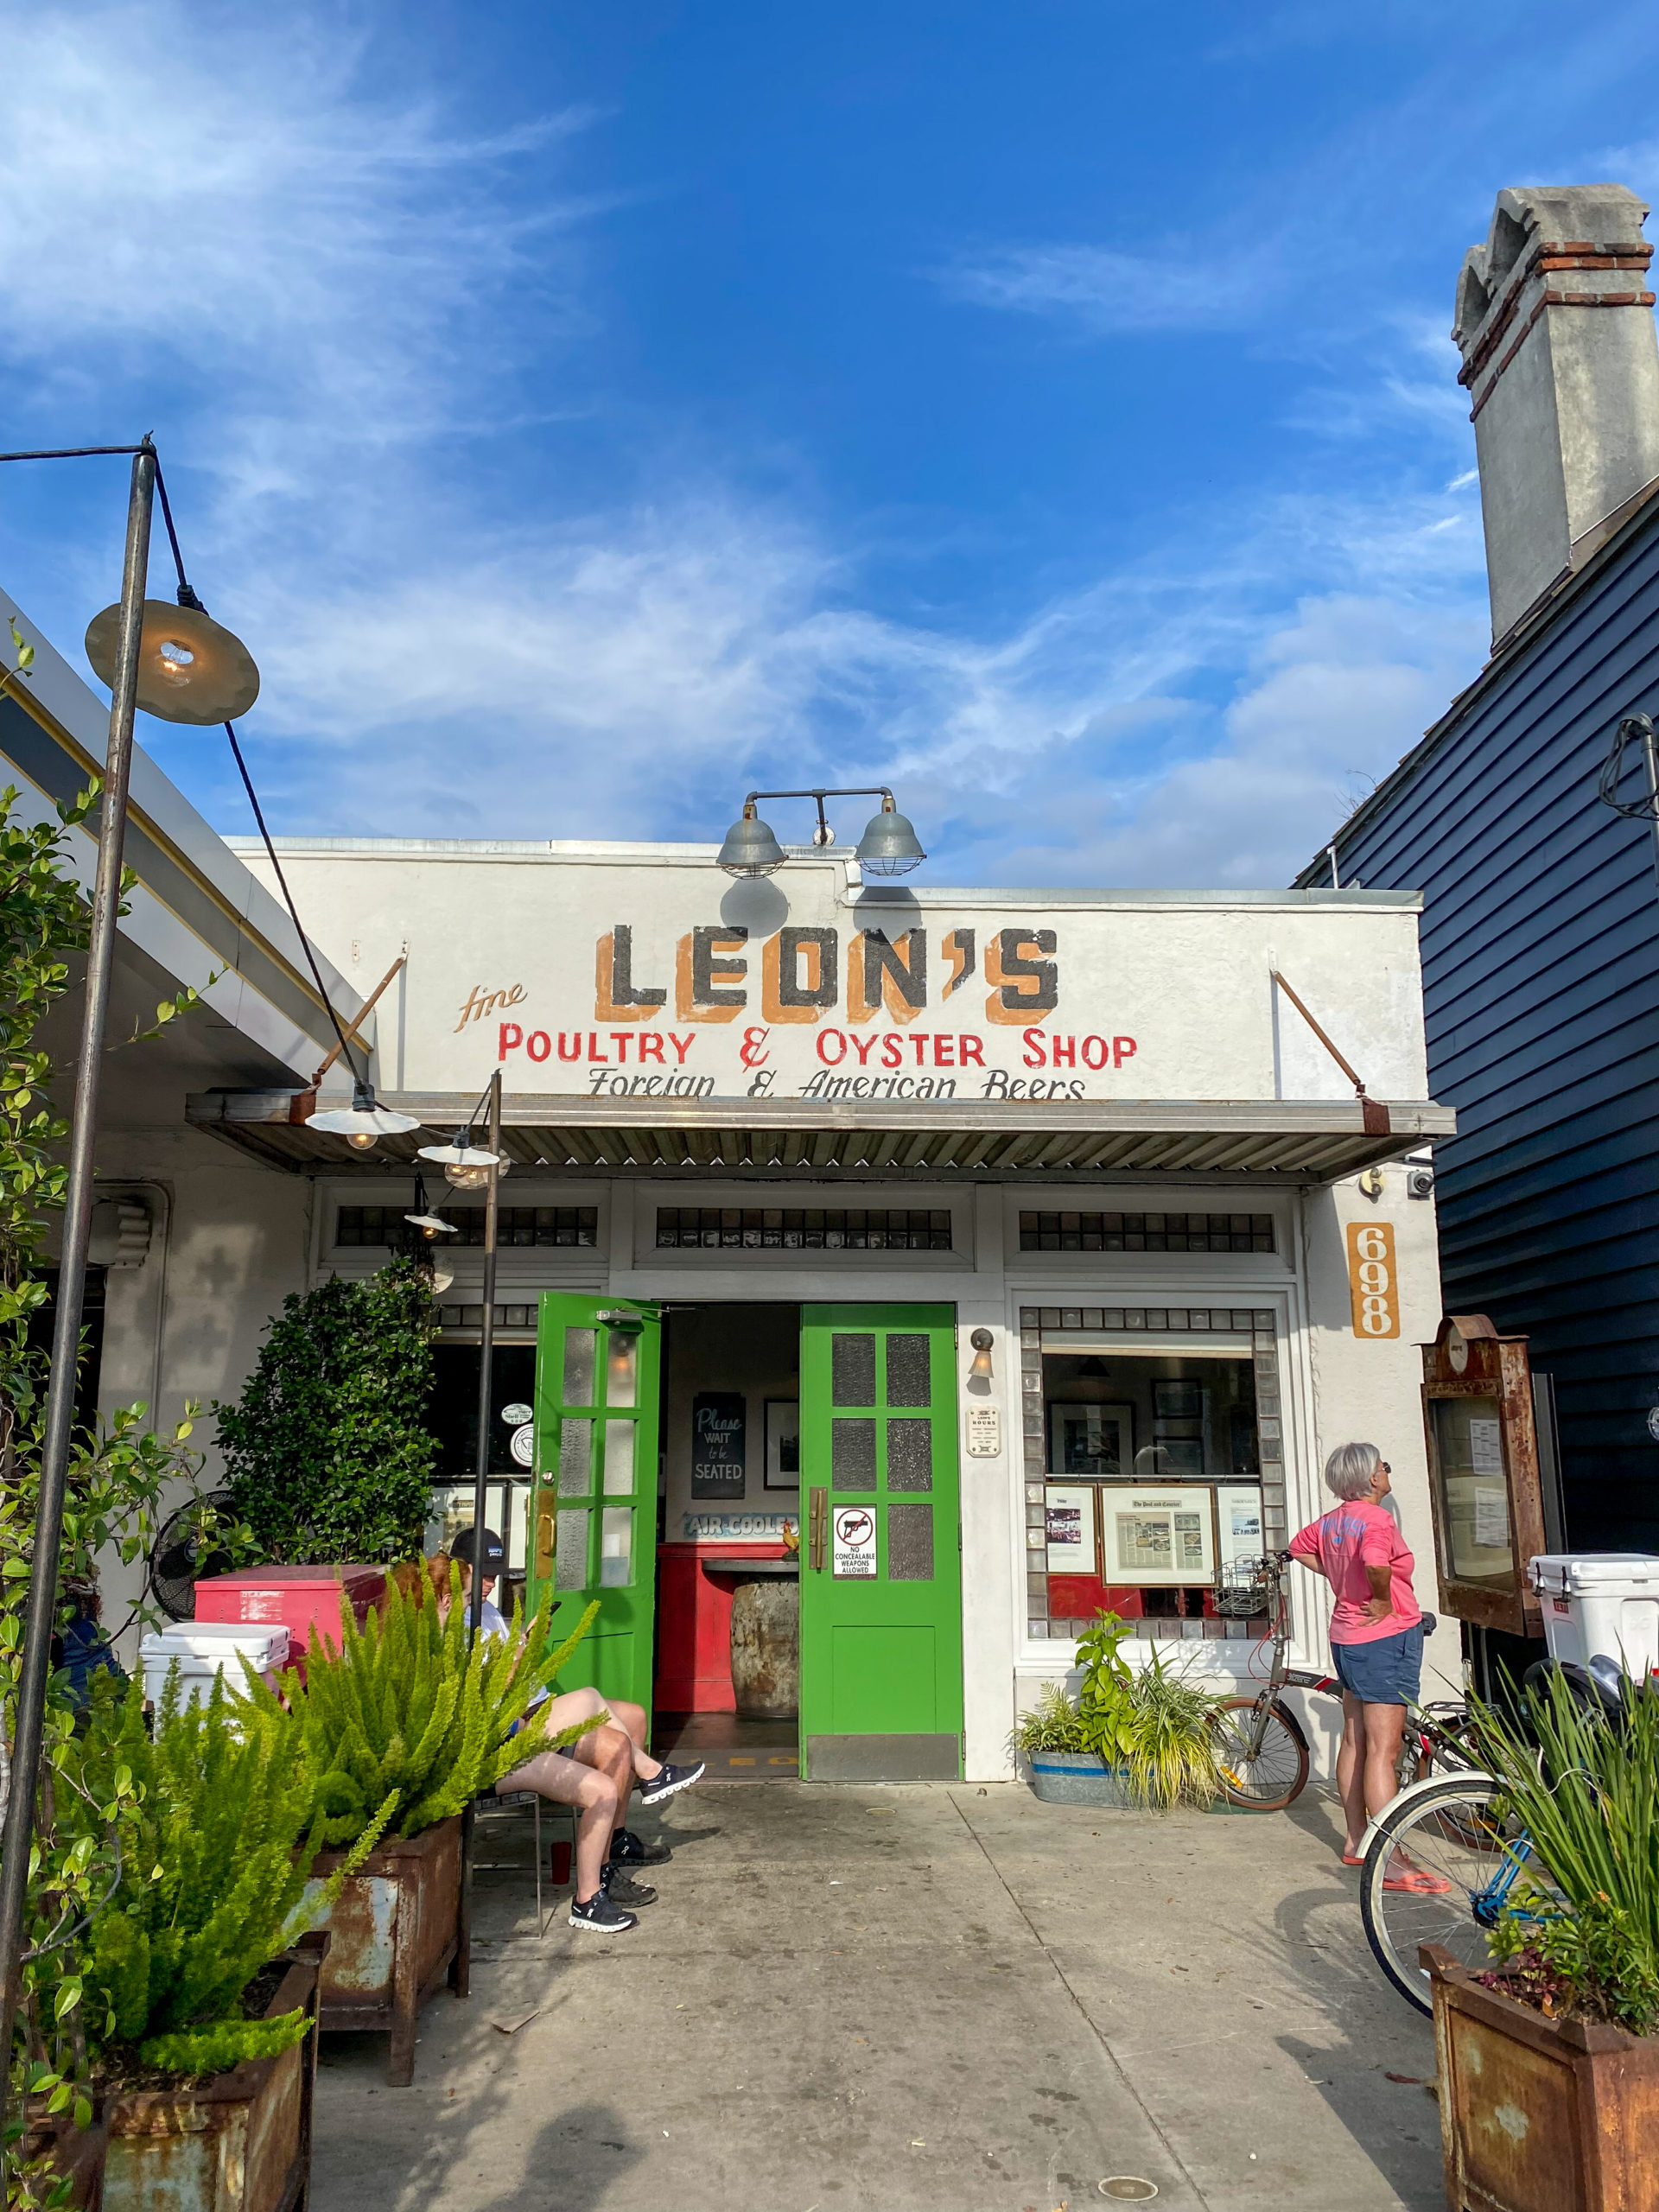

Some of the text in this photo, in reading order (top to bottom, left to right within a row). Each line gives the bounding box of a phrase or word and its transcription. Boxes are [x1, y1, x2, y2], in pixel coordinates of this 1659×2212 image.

[595, 925, 1058, 1025] LEON'S
[453, 983, 528, 1033] fine
[499, 1022, 1138, 1072] POULTRY & OYSTER SHOP
[747, 1071, 777, 1097] &
[798, 1069, 957, 1098] American
[981, 1070, 1086, 1100] Beers
[1357, 1227, 1392, 1335] 698
[696, 1408, 742, 1433] Please
[704, 1433, 731, 1444] WAIT
[709, 1446, 730, 1459] to be
[695, 1464, 742, 1479] SEATED
